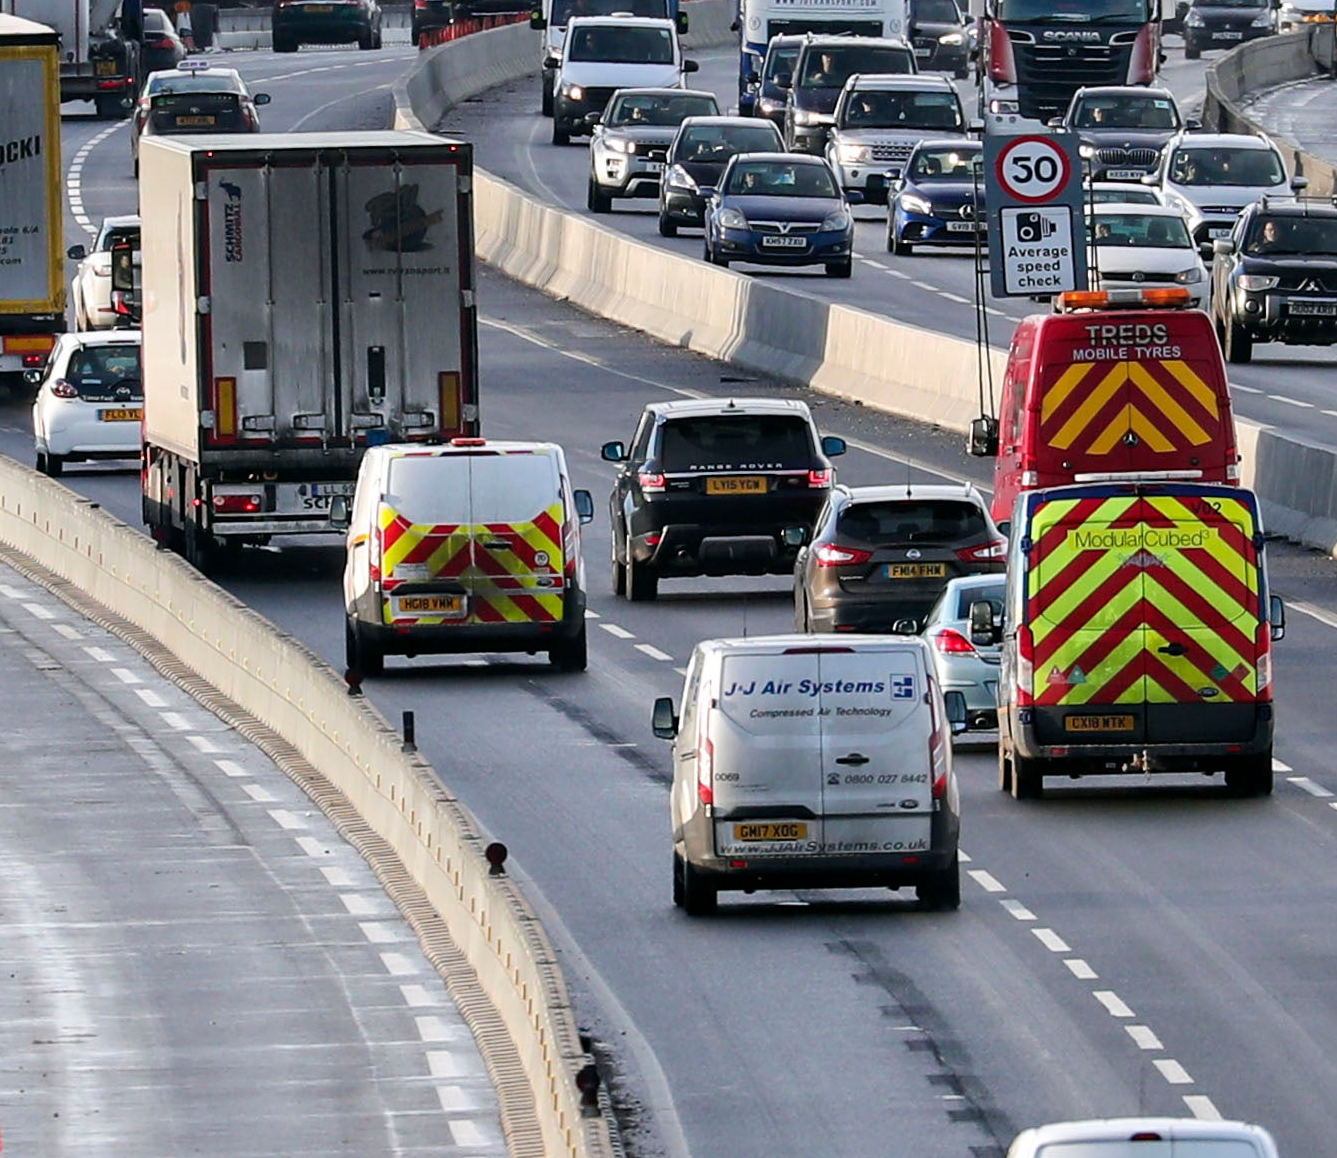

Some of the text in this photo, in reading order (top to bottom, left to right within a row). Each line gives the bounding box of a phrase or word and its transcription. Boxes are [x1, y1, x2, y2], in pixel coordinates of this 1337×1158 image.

[1043, 31, 1101, 42] SCANIA
[1012, 156, 1058, 183] 50
[225, 203, 234, 262] SCHMITZ
[1008, 246, 1068, 259] Average
[1017, 260, 1060, 274] speed
[1018, 275, 1061, 287] check
[1084, 323, 1168, 346] TREDS
[1073, 346, 1181, 361] MOBILE TYRES
[405, 598, 429, 609] HG18
[761, 680, 793, 695] Air
[797, 678, 885, 698] Systems
[750, 707, 892, 719] Compressed Air Technology
[1072, 717, 1099, 729] CX18
[715, 773, 740, 782] 0069
[844, 773, 927, 784] 0800 027 8442
[720, 838, 927, 855] www.JJAirSystems.co.uk
